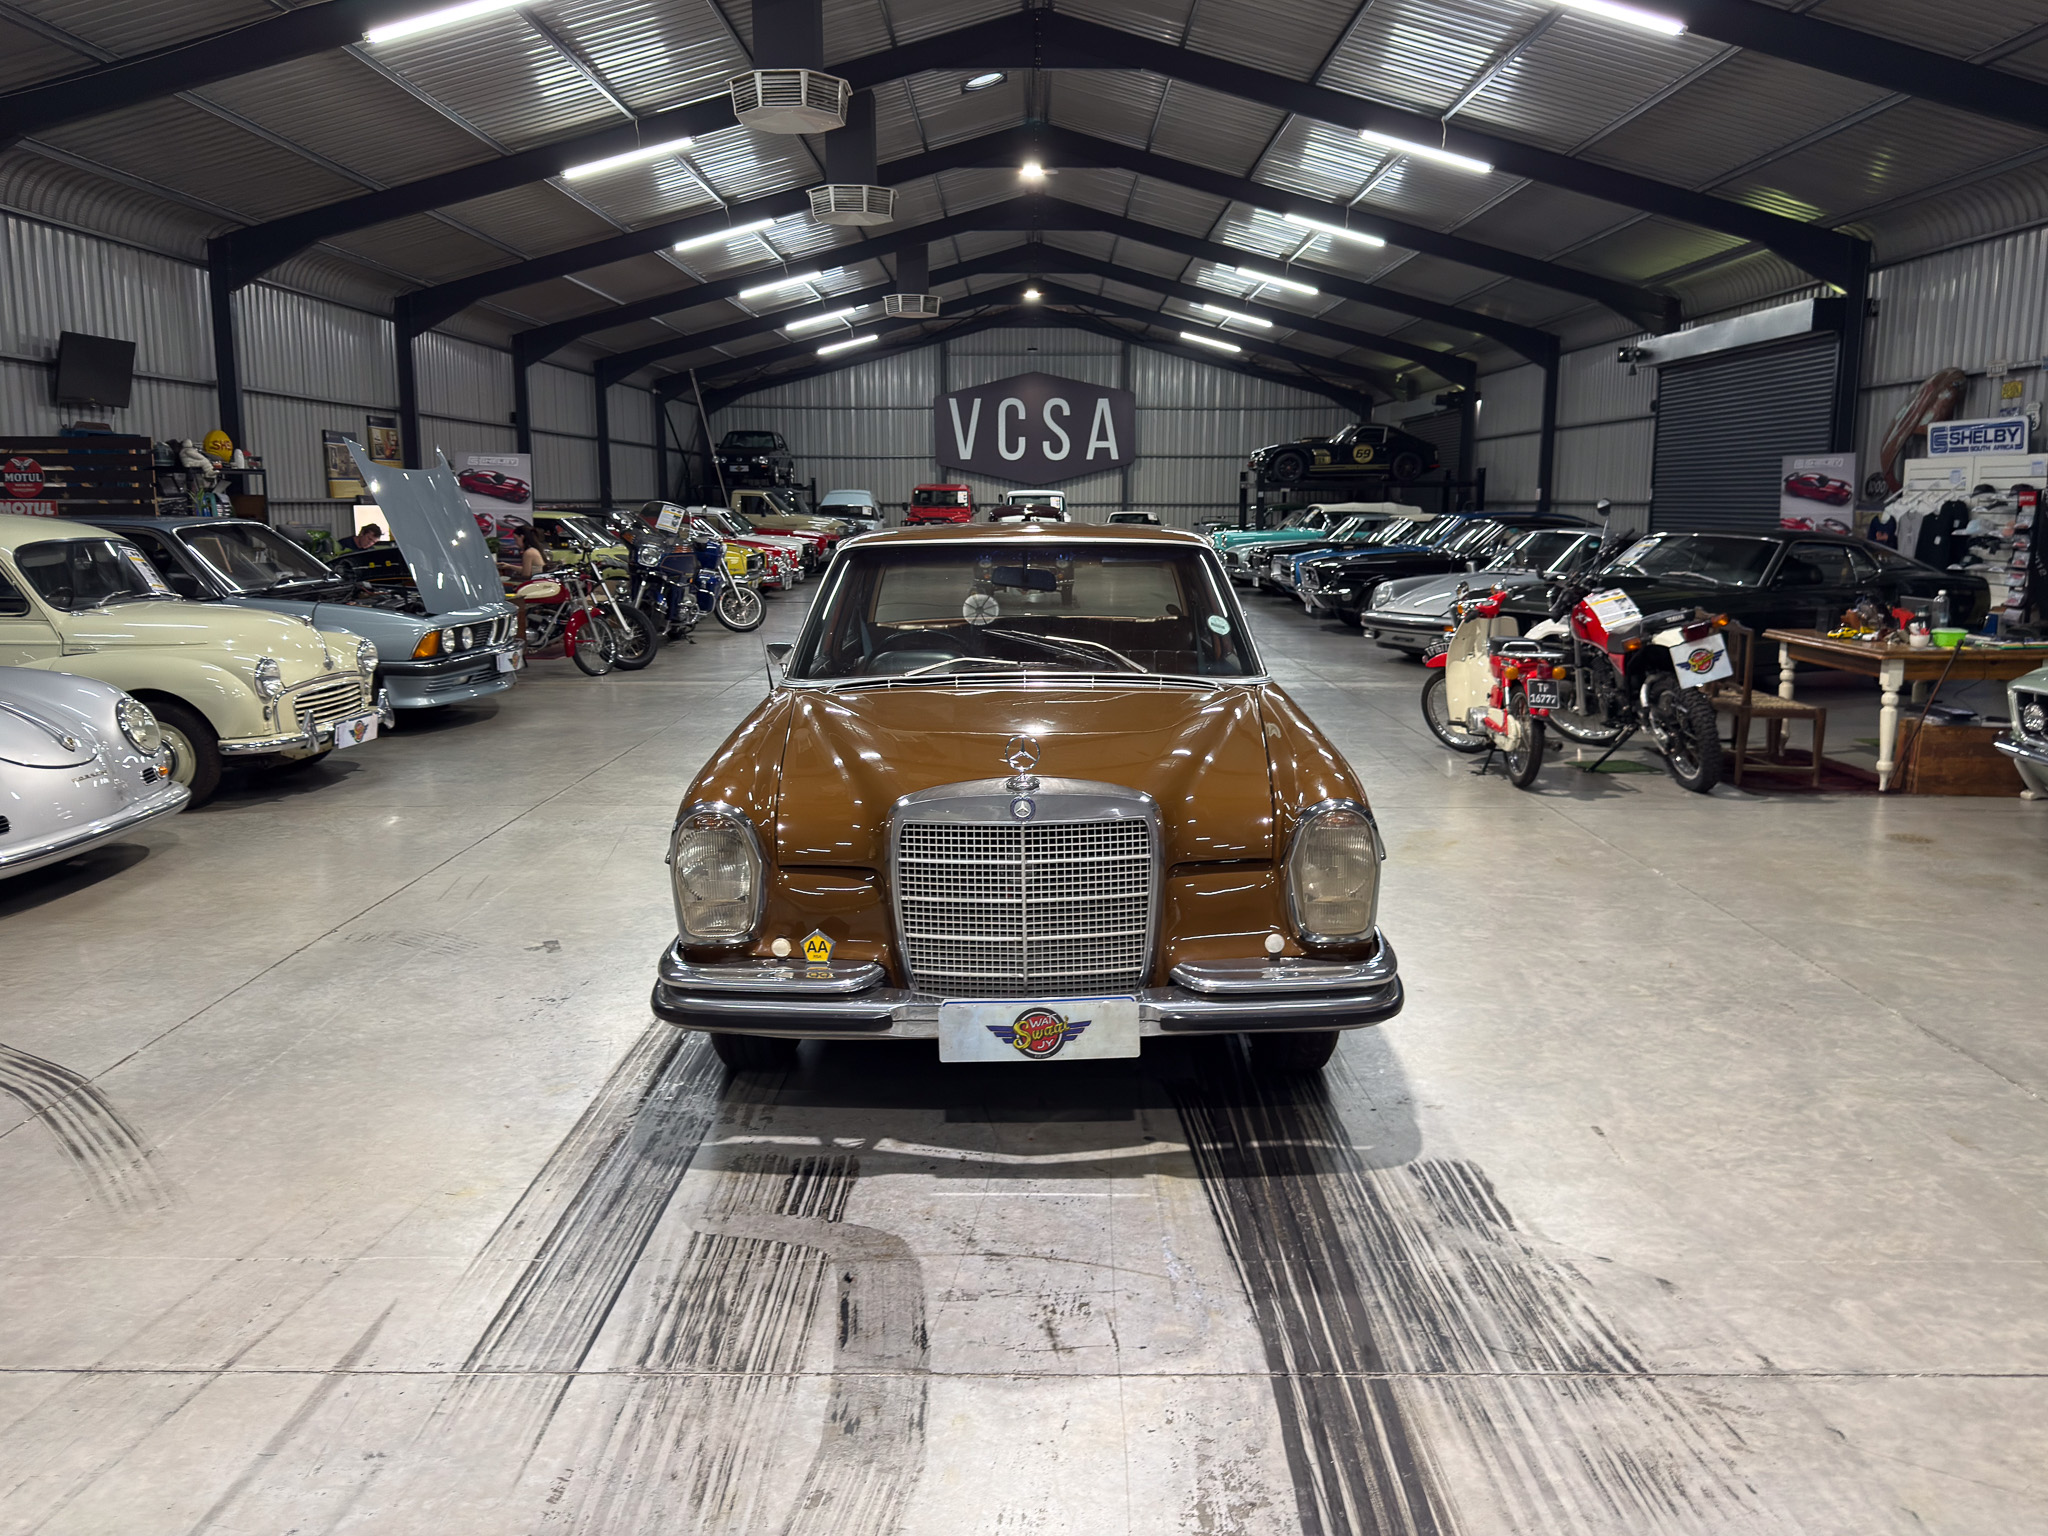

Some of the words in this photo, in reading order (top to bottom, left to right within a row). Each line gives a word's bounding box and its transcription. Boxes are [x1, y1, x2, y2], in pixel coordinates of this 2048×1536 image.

[949, 397, 1119, 461] VCSA
[1949, 428, 2019, 445] SHELBY
[1993, 443, 2014, 451] AFRICA
[1356, 448, 1371, 459] 69
[4, 473, 42, 482] MOTUL
[0, 502, 55, 515] MOTUL
[1537, 683, 1549, 692] TP
[807, 941, 828, 953] AA
[1028, 1013, 1057, 1028] WAT
[1013, 1015, 1070, 1049] Swaai
[1037, 1039, 1054, 1049] JY
